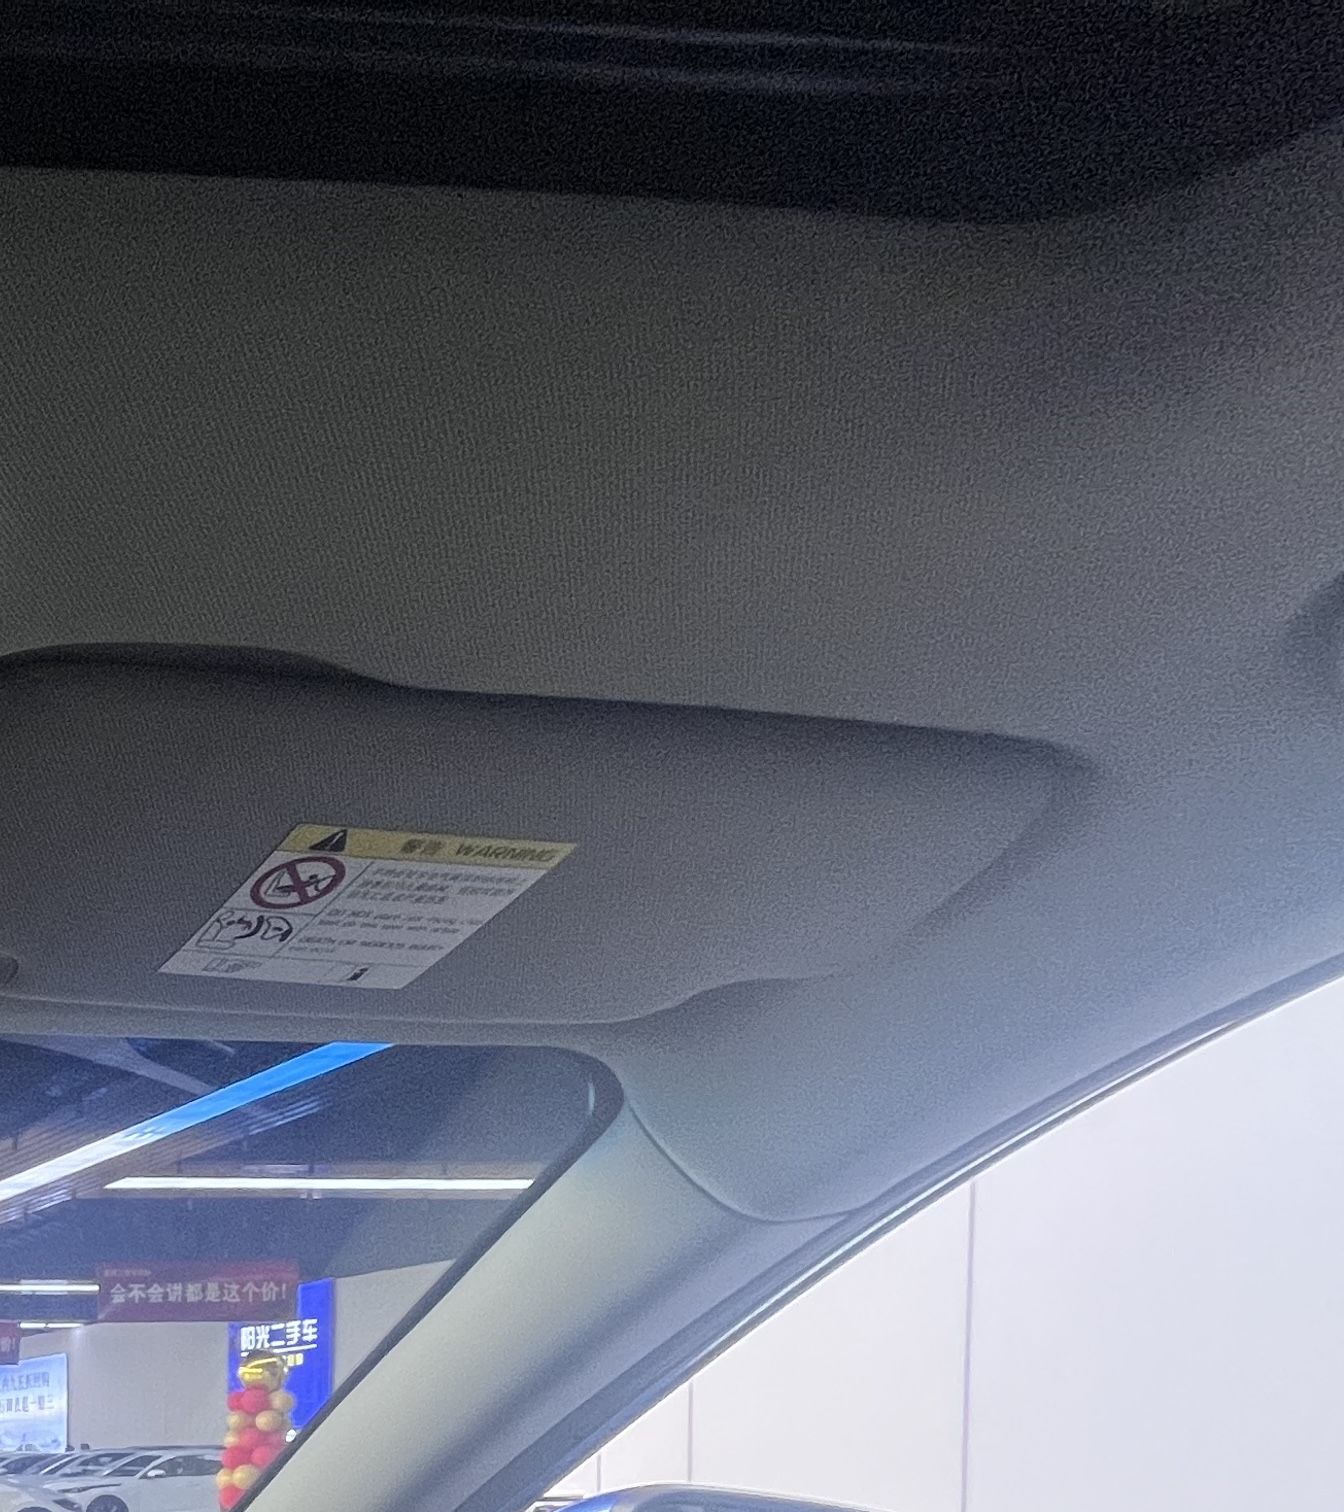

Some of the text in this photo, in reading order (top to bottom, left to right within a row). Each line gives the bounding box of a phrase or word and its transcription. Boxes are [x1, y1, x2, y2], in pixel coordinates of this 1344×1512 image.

[455, 843, 557, 862] WARNING
[240, 1318, 318, 1351] 阳光二手车
